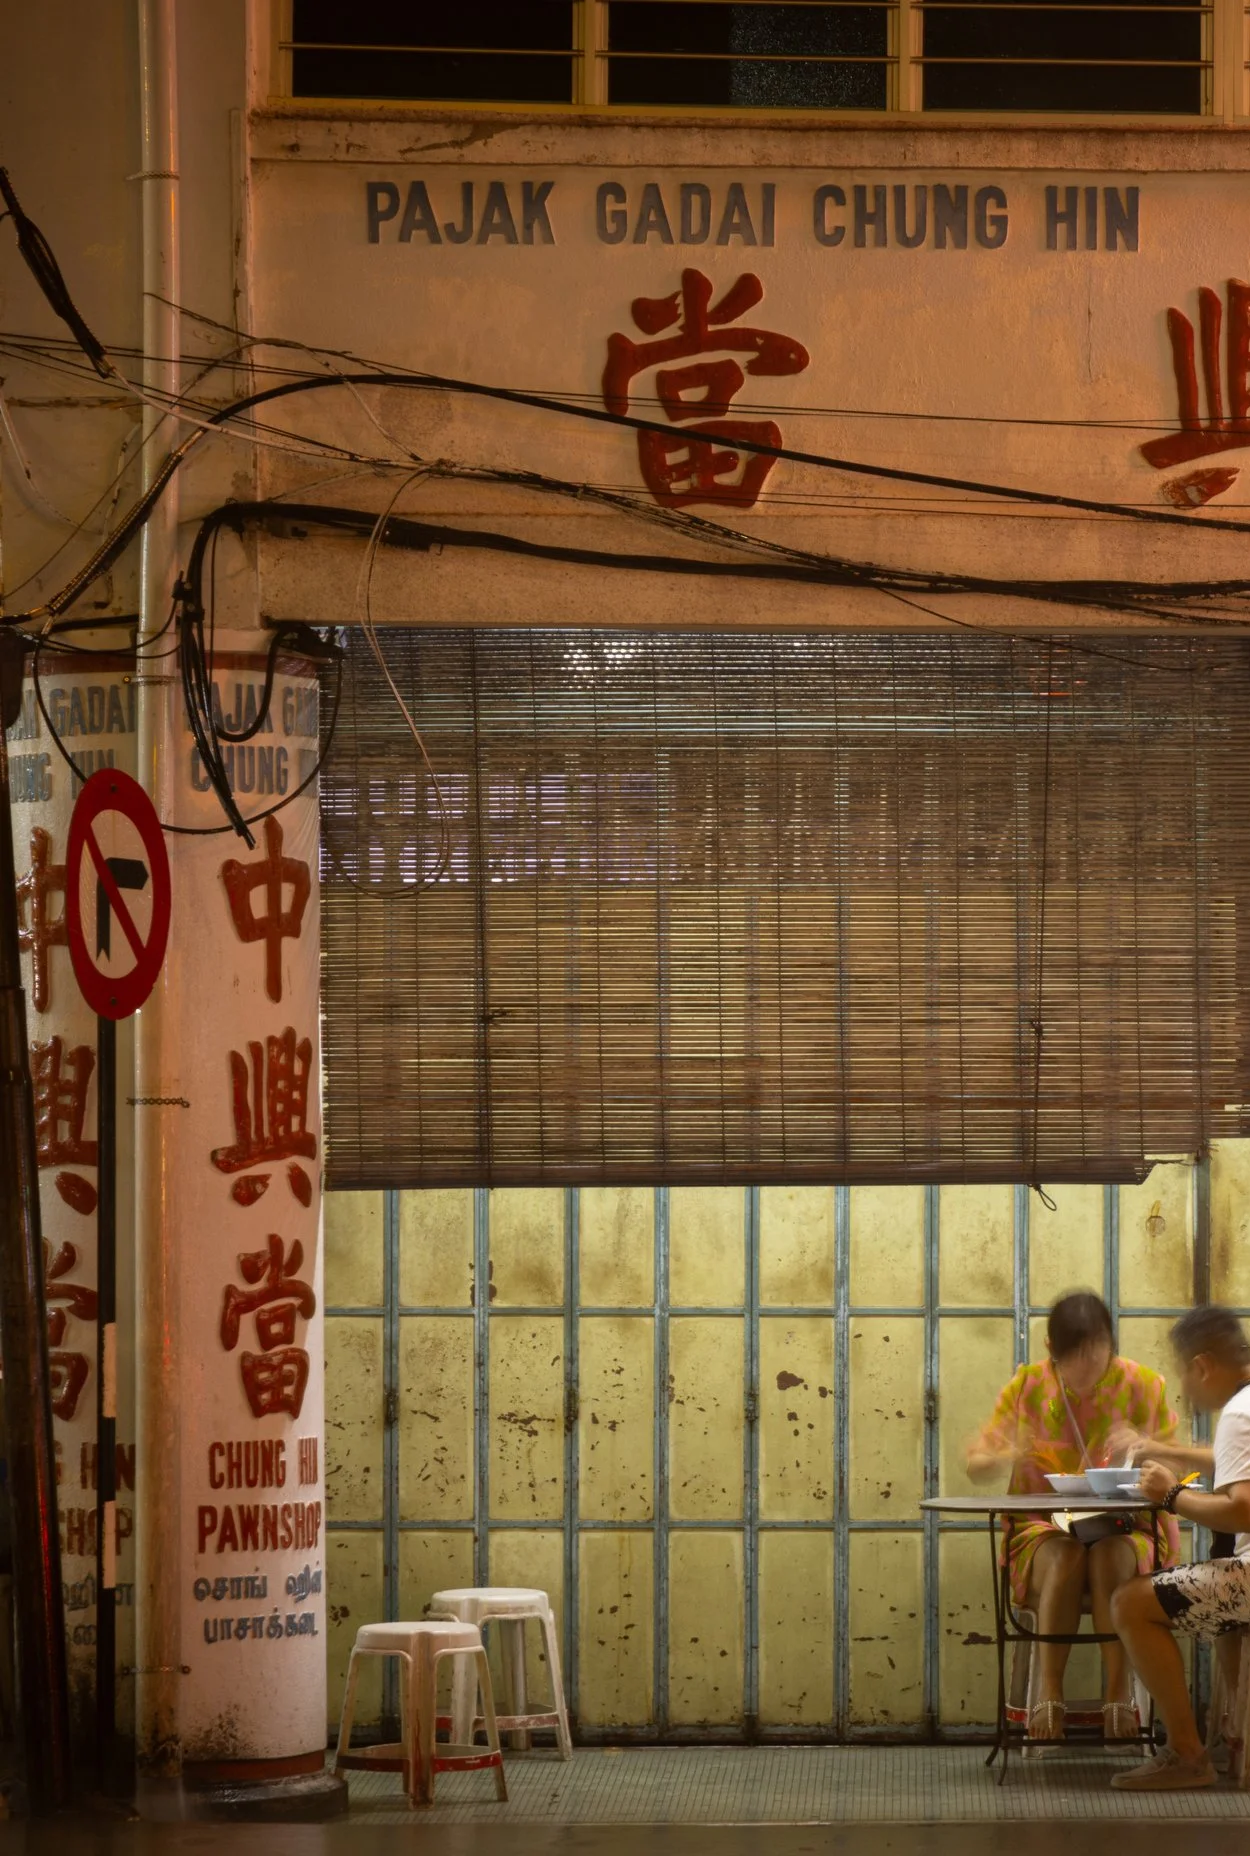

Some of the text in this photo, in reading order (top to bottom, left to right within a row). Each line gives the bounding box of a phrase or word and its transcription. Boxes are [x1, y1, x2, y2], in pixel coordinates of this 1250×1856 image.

[366, 180, 1141, 251] PAJAK GADAI CHUNG HIN
[208, 1439, 287, 1490] CHUNG
[197, 1501, 321, 1554] PAWNSHOP
